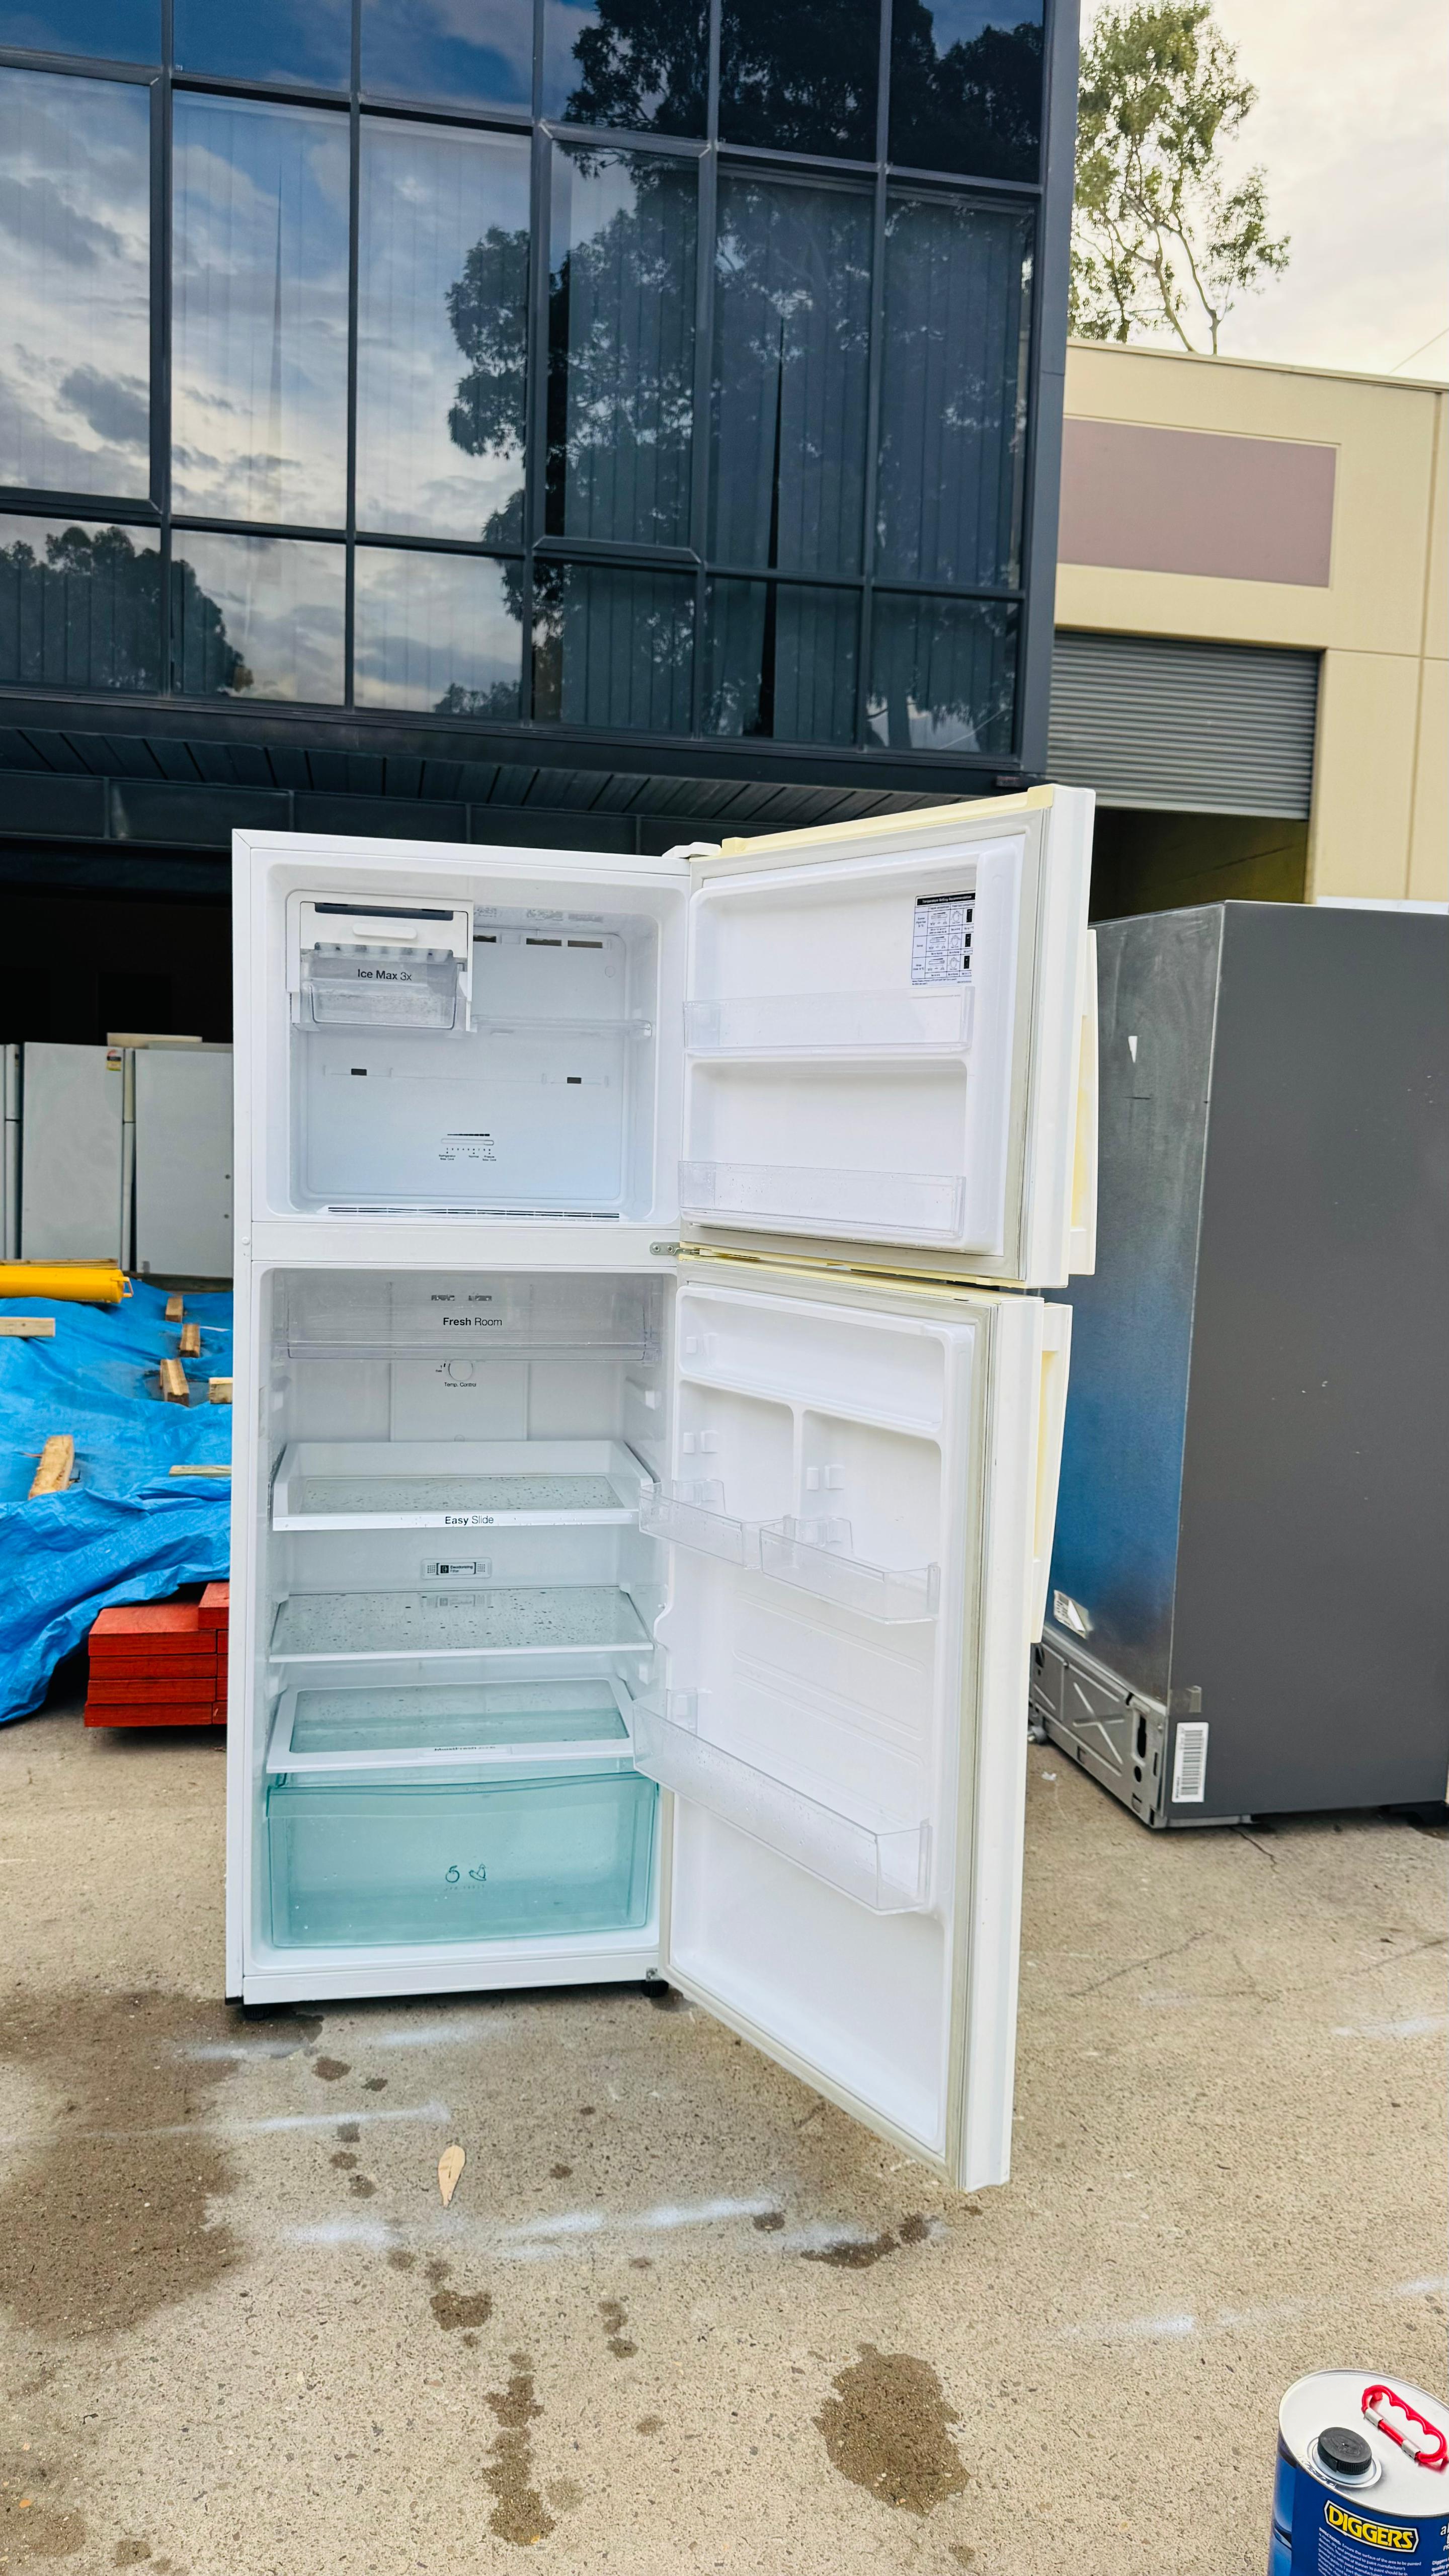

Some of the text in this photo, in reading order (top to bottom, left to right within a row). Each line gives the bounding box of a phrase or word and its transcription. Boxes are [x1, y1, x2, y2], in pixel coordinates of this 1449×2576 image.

[358, 969, 412, 981] Ice Max 3x
[443, 1317, 502, 1326] Fresh Room
[445, 1515, 494, 1525] Easy Slide
[1329, 2505, 1413, 2549] DIGGERS
